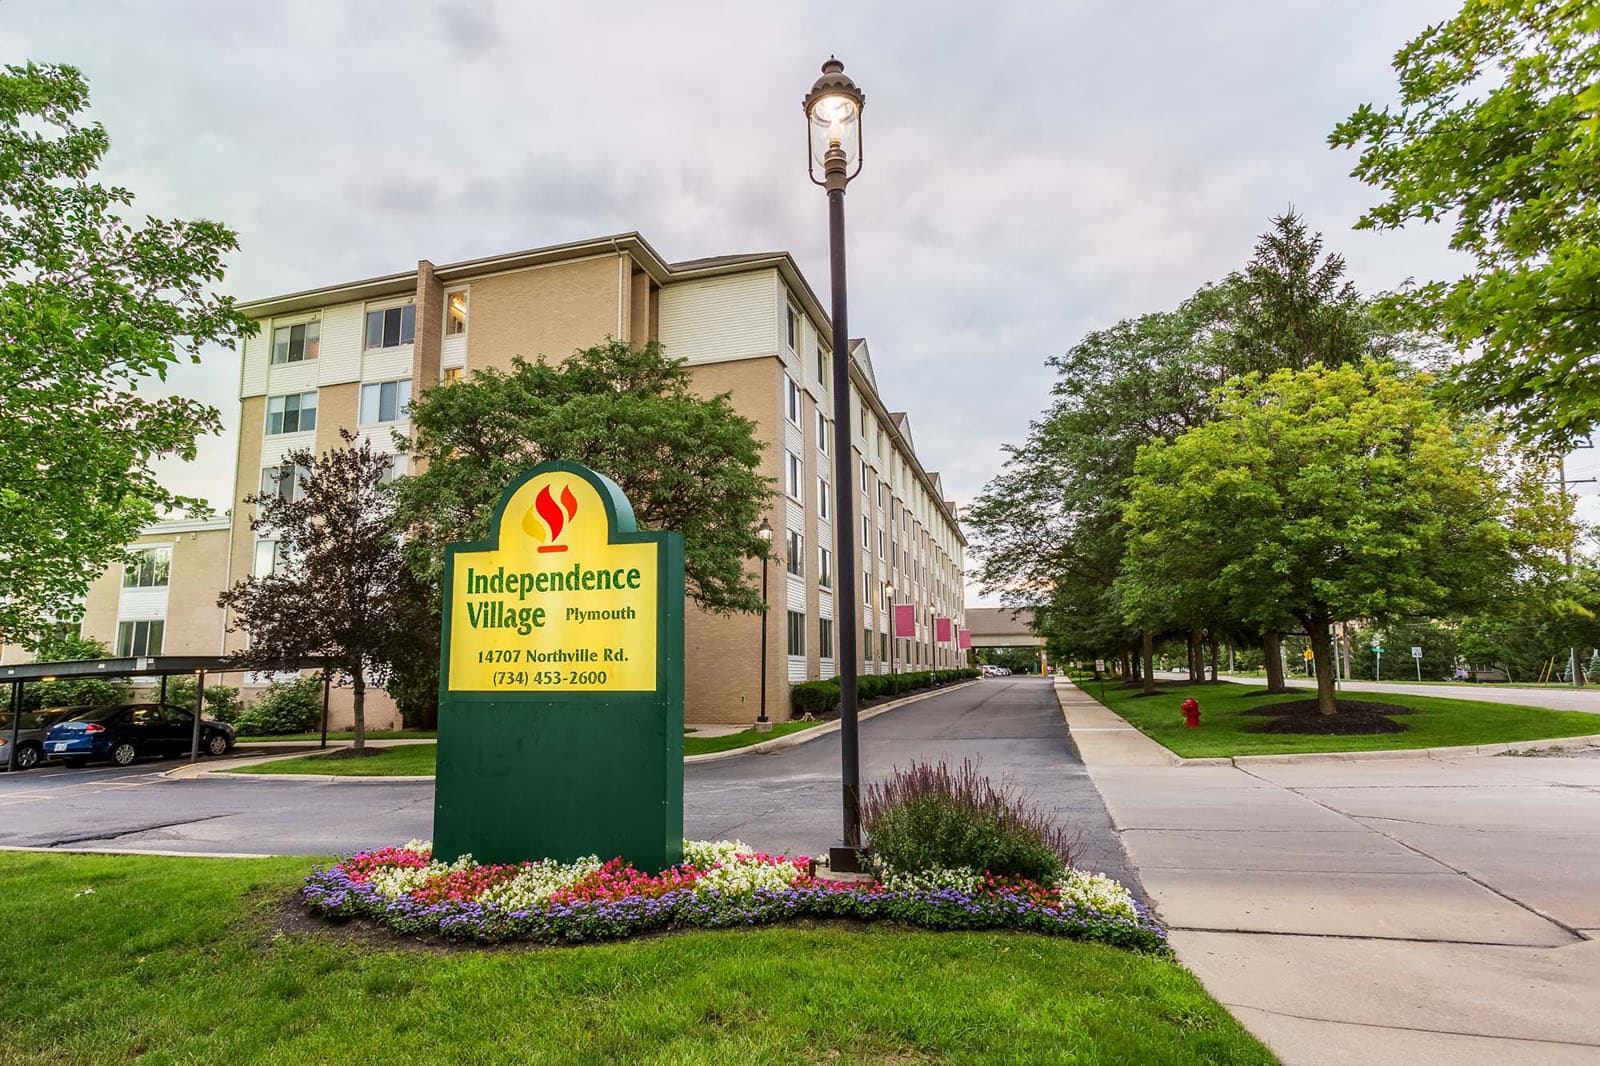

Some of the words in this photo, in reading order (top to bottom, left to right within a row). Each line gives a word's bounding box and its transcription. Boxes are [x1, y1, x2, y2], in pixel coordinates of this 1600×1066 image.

[466, 563, 641, 600] Independence
[466, 600, 546, 635] Village
[566, 606, 636, 624] Plymouth
[477, 650, 520, 664] 14707
[526, 648, 598, 663] Northville
[603, 648, 629, 662] Rd.
[492, 671, 528, 686] (734)
[533, 671, 607, 685] 453-2600
